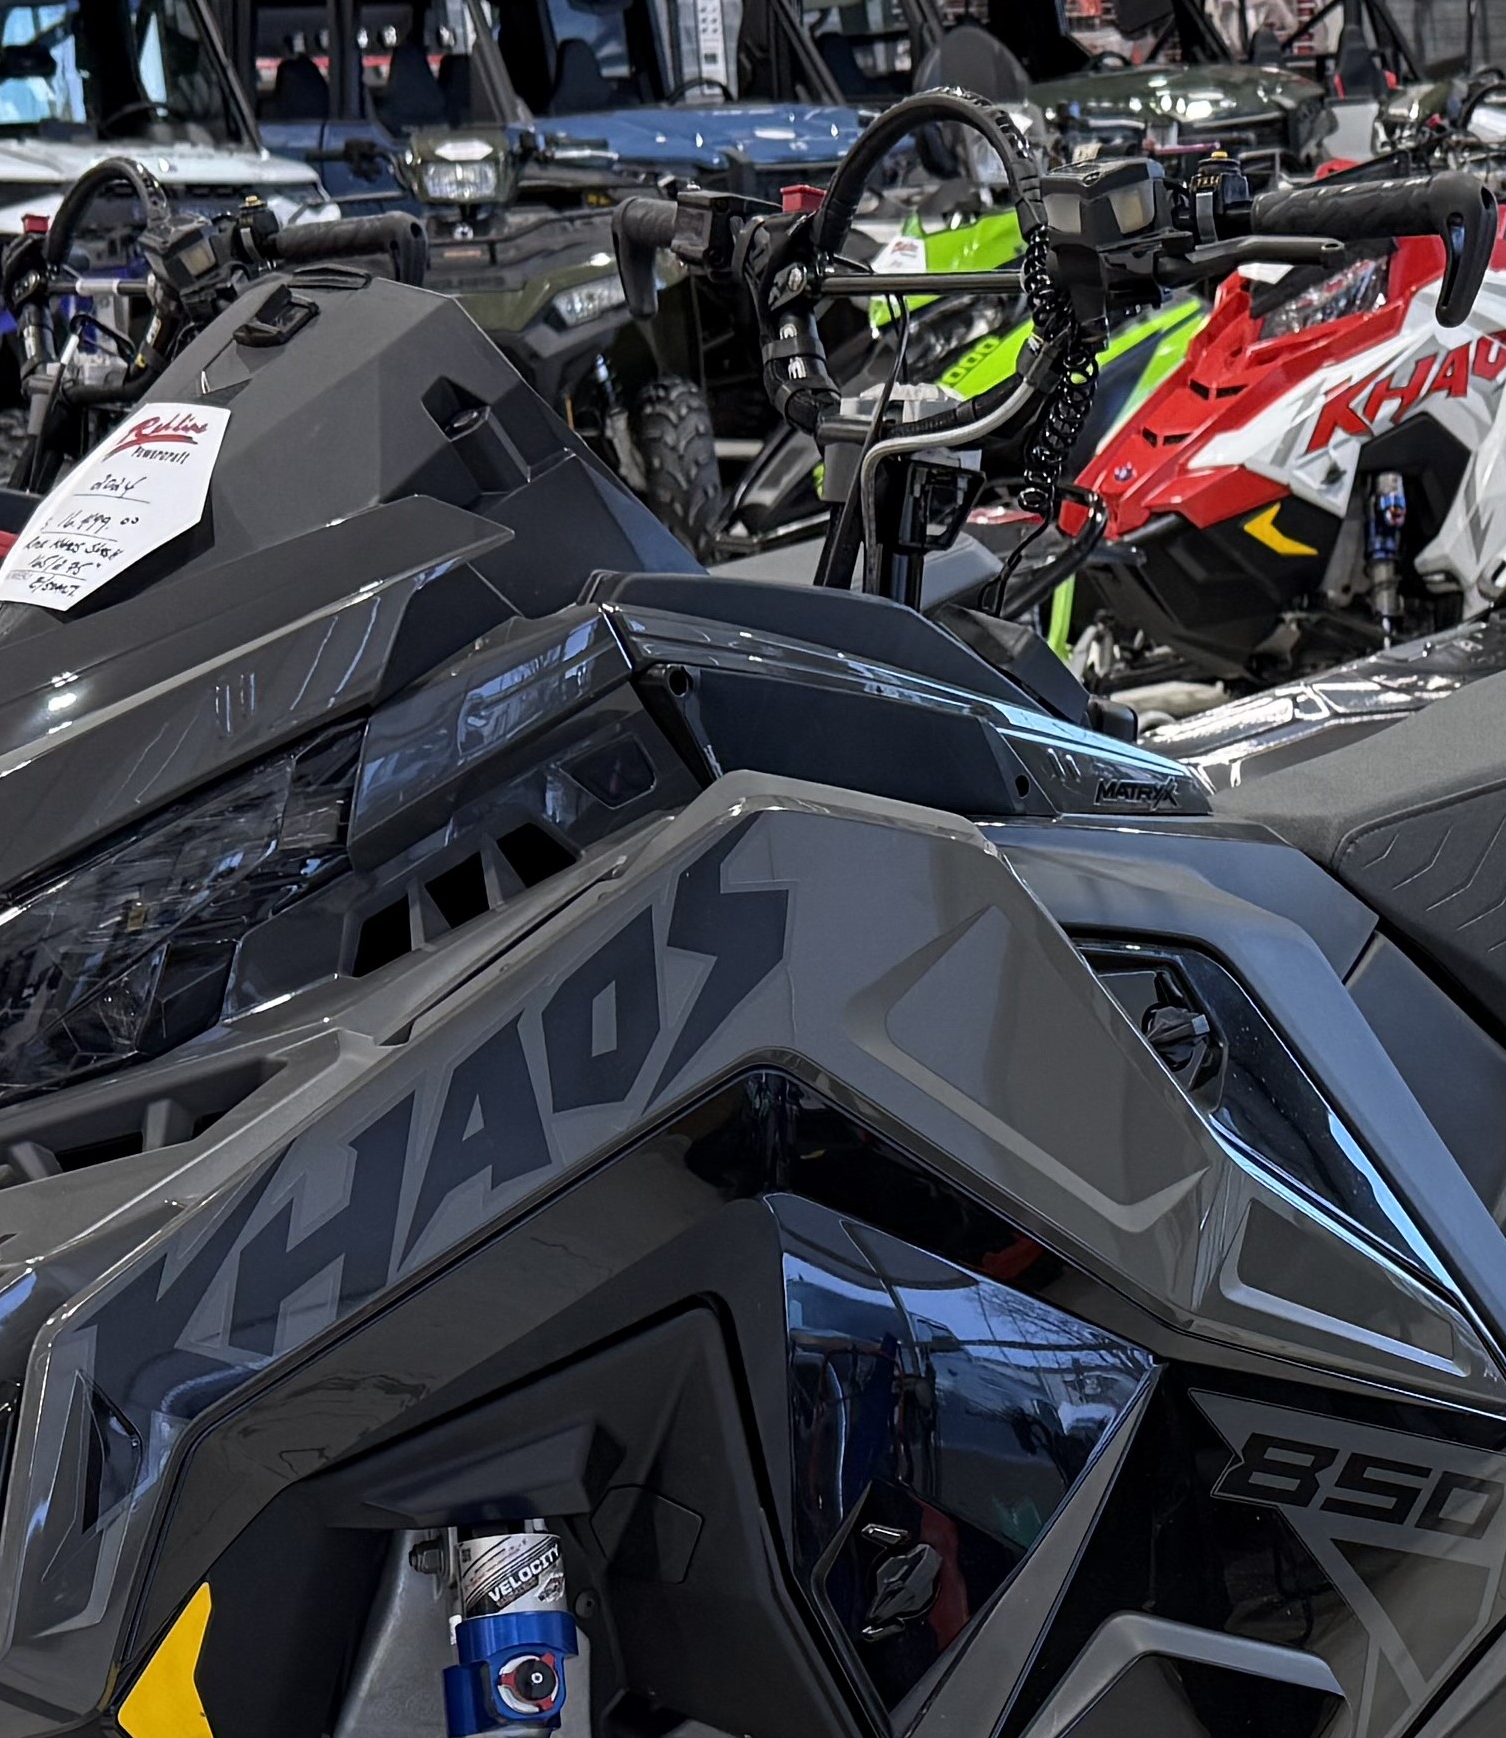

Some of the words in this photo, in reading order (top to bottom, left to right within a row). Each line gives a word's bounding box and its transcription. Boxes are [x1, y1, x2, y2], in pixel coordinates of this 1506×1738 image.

[1094, 776, 1181, 812] MATRYX
[75, 808, 791, 1440] KHAOS
[1229, 1431, 1506, 1540] 850
[488, 1544, 560, 1603] VELOCITY
